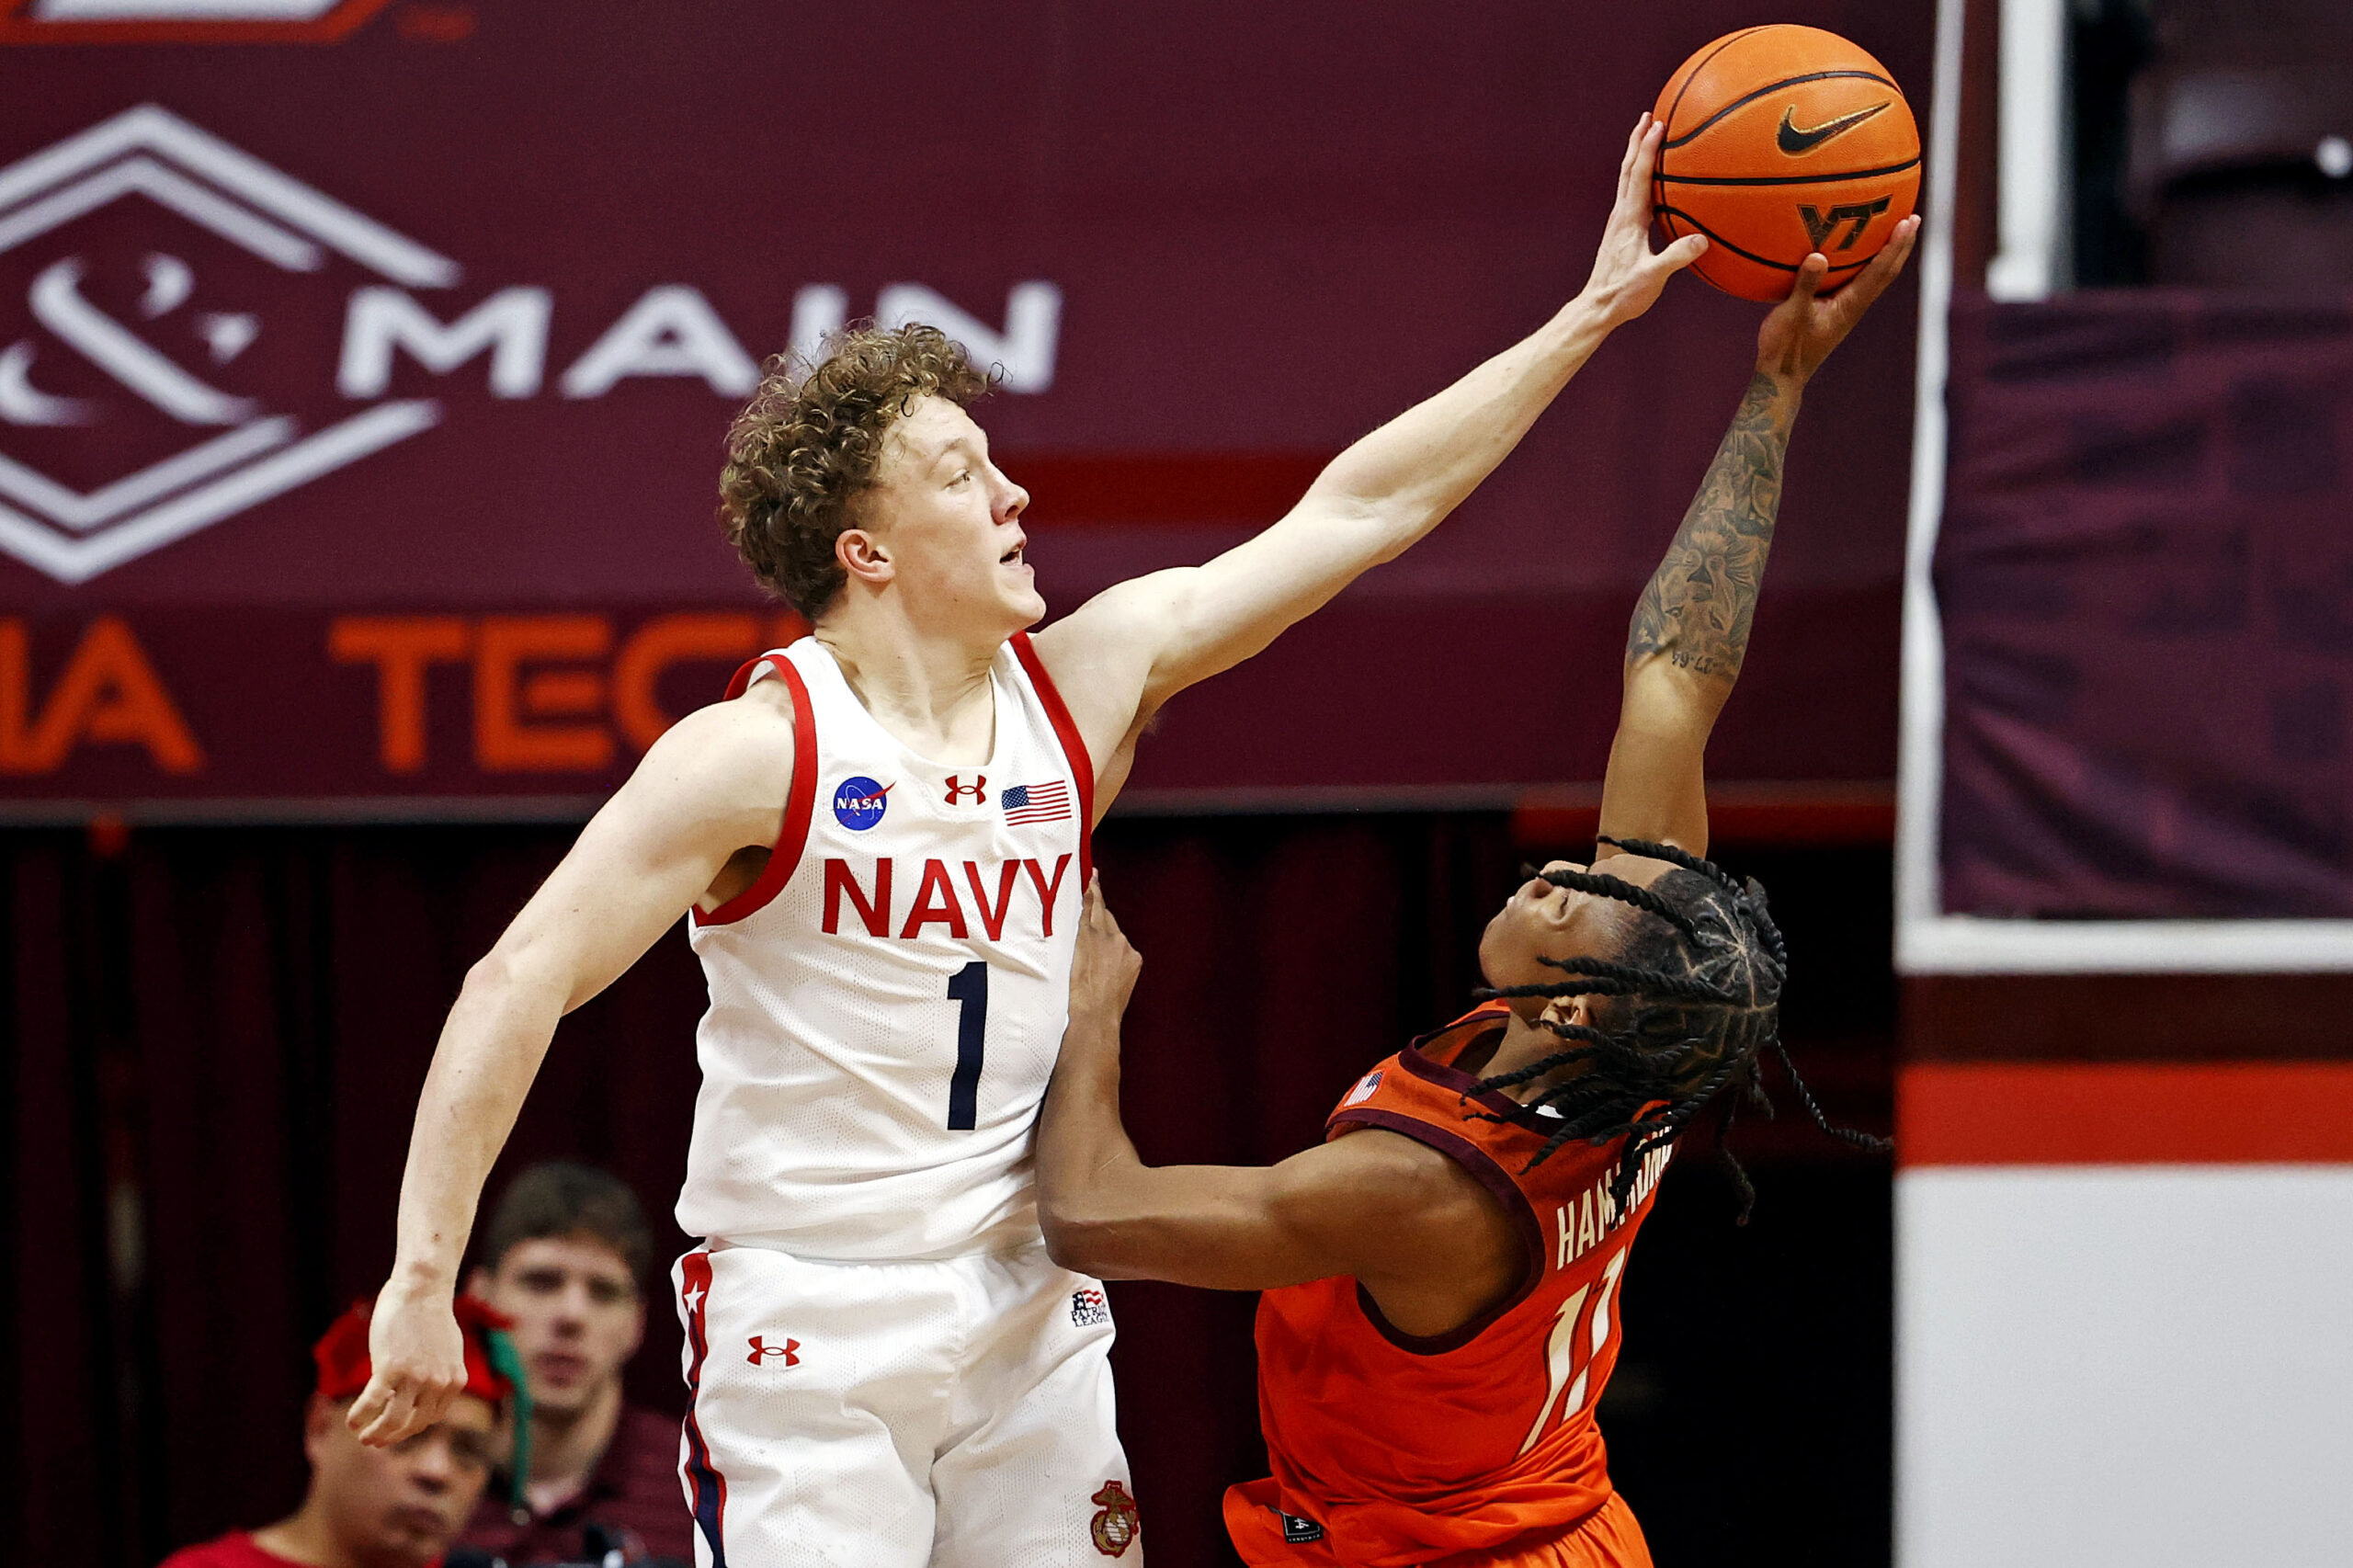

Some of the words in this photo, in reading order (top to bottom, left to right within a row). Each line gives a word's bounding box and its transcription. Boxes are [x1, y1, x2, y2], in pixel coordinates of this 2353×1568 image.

[336, 282, 1063, 400] MAIN
[327, 613, 814, 775] TEC
[836, 797, 883, 810] NASA
[822, 853, 1073, 942] NAVY
[947, 961, 987, 1131] 1
[1513, 1246, 1627, 1461] 11
